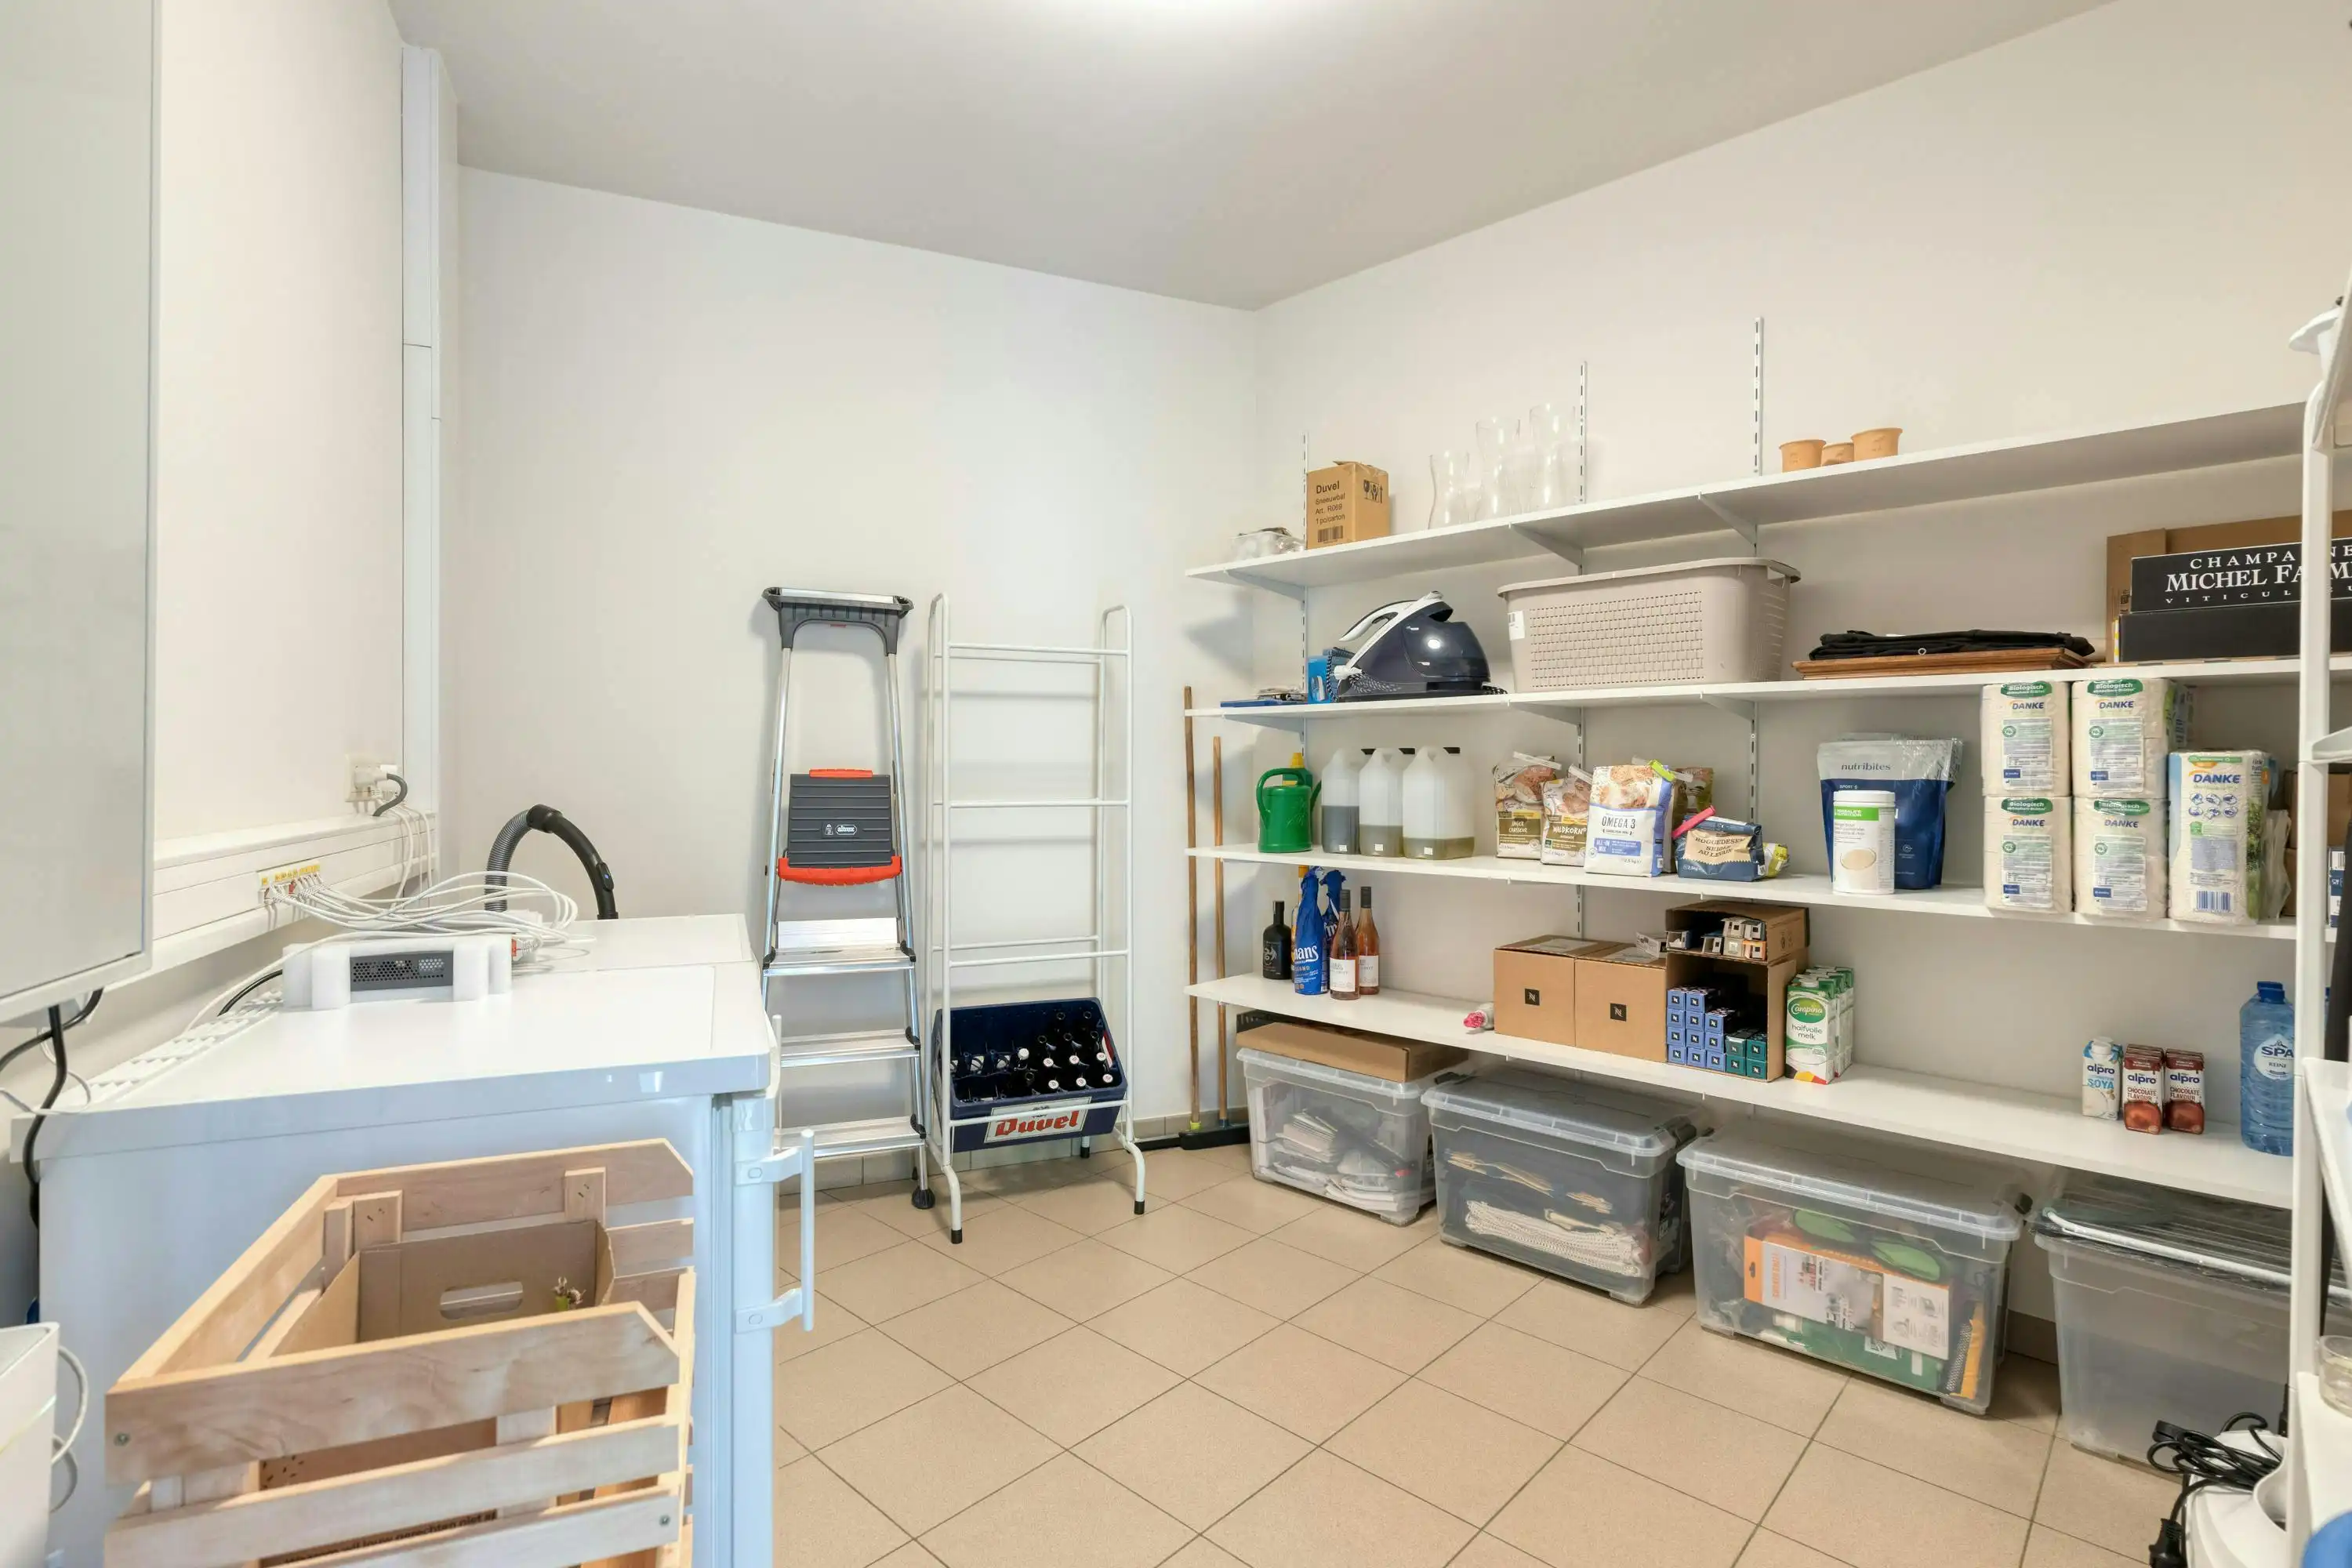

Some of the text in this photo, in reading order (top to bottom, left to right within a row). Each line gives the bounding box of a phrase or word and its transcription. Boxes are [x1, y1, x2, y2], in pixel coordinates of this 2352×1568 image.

[1316, 481, 1340, 494] Duvel
[2165, 568, 2267, 593] MICHEL
[2099, 700, 2135, 710] DANKE
[1841, 762, 1892, 771] nutribites
[2193, 774, 2241, 783] DANKE
[1602, 816, 1636, 829] OMEGA 3
[2013, 818, 2045, 827] DANKE
[2104, 819, 2140, 828] DANKE
[1791, 1004, 1823, 1016] Campina
[1791, 1023, 1823, 1033] halfvolle
[2261, 1047, 2294, 1058] SPA
[2087, 1064, 2115, 1074] alpro
[2127, 1073, 2156, 1084] alpro
[2169, 1073, 2200, 1083] alpro
[2088, 1079, 2114, 1089] SOYA
[2127, 1087, 2157, 1095] CHOCOLATE
[2169, 1087, 2200, 1095] CHOCOLATE
[995, 1109, 1080, 1138] Duvel
